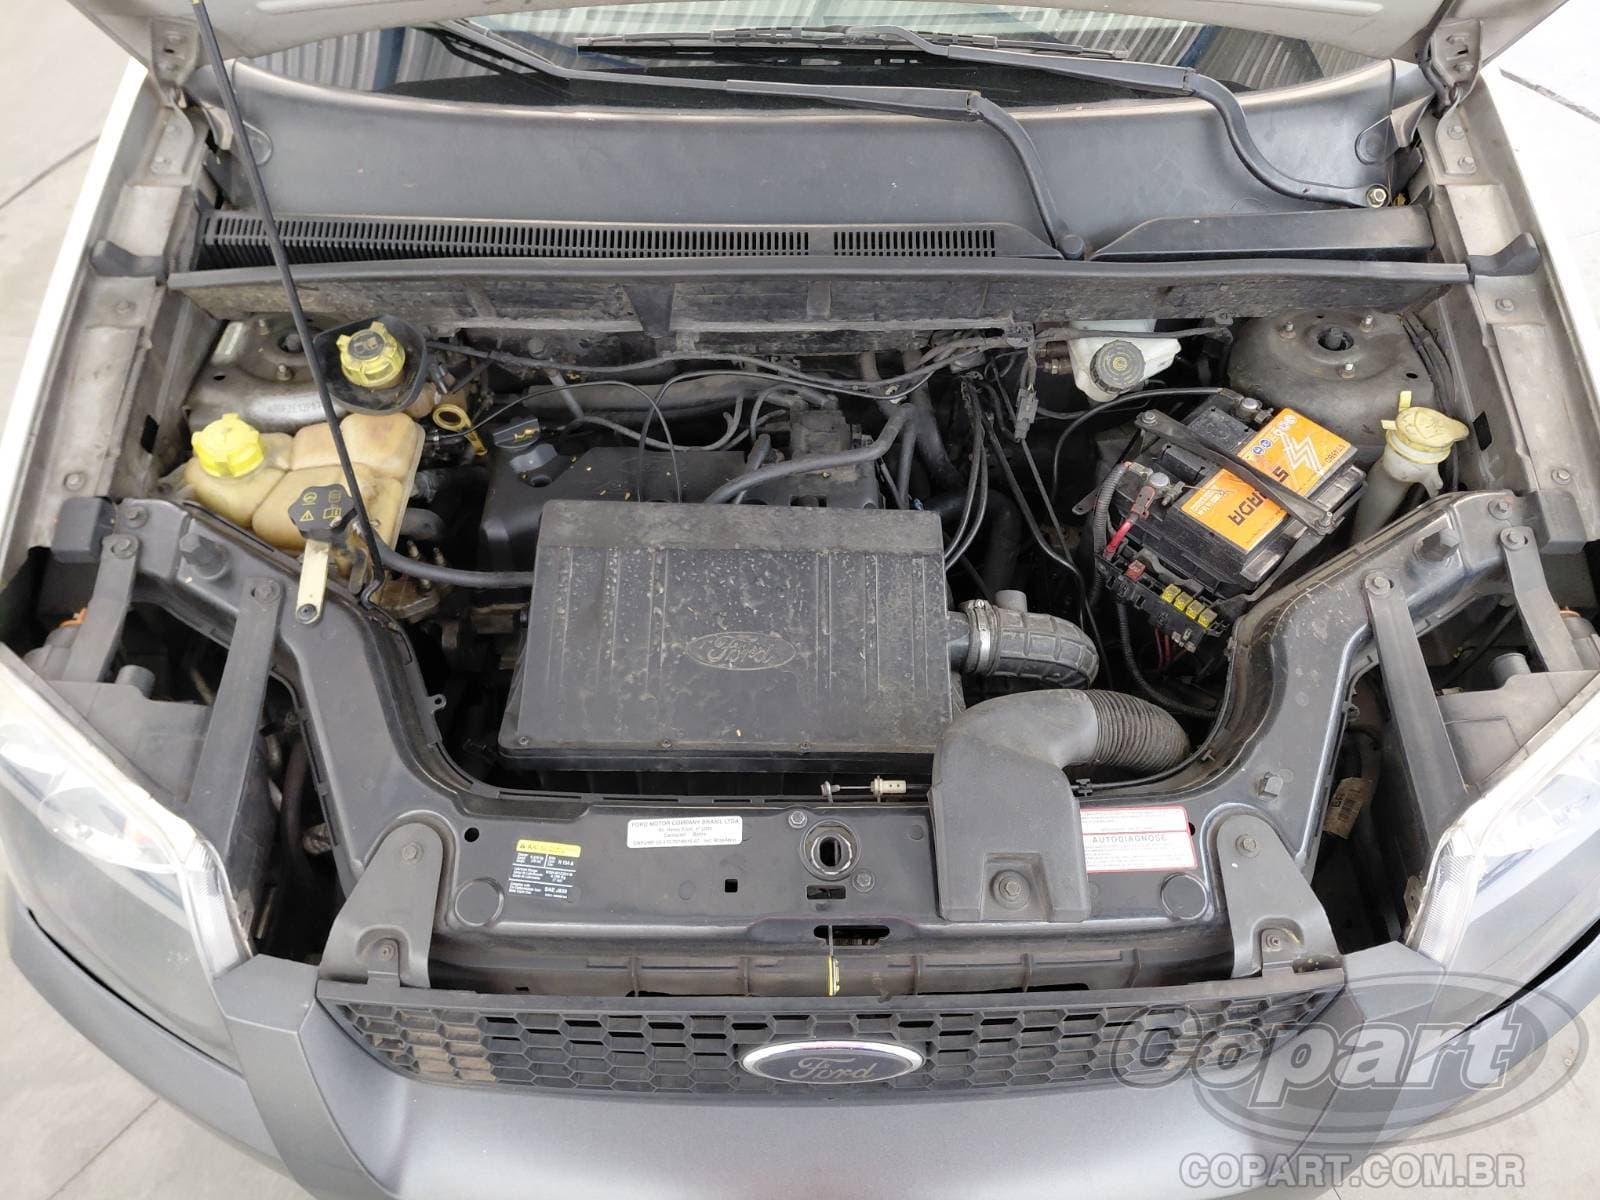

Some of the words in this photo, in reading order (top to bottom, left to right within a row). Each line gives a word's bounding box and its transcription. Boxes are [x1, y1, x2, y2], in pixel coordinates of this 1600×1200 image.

[706, 634, 775, 664] Ford
[1091, 833, 1168, 844] AUTODIAGNOSE
[789, 1056, 879, 1080] Ford
